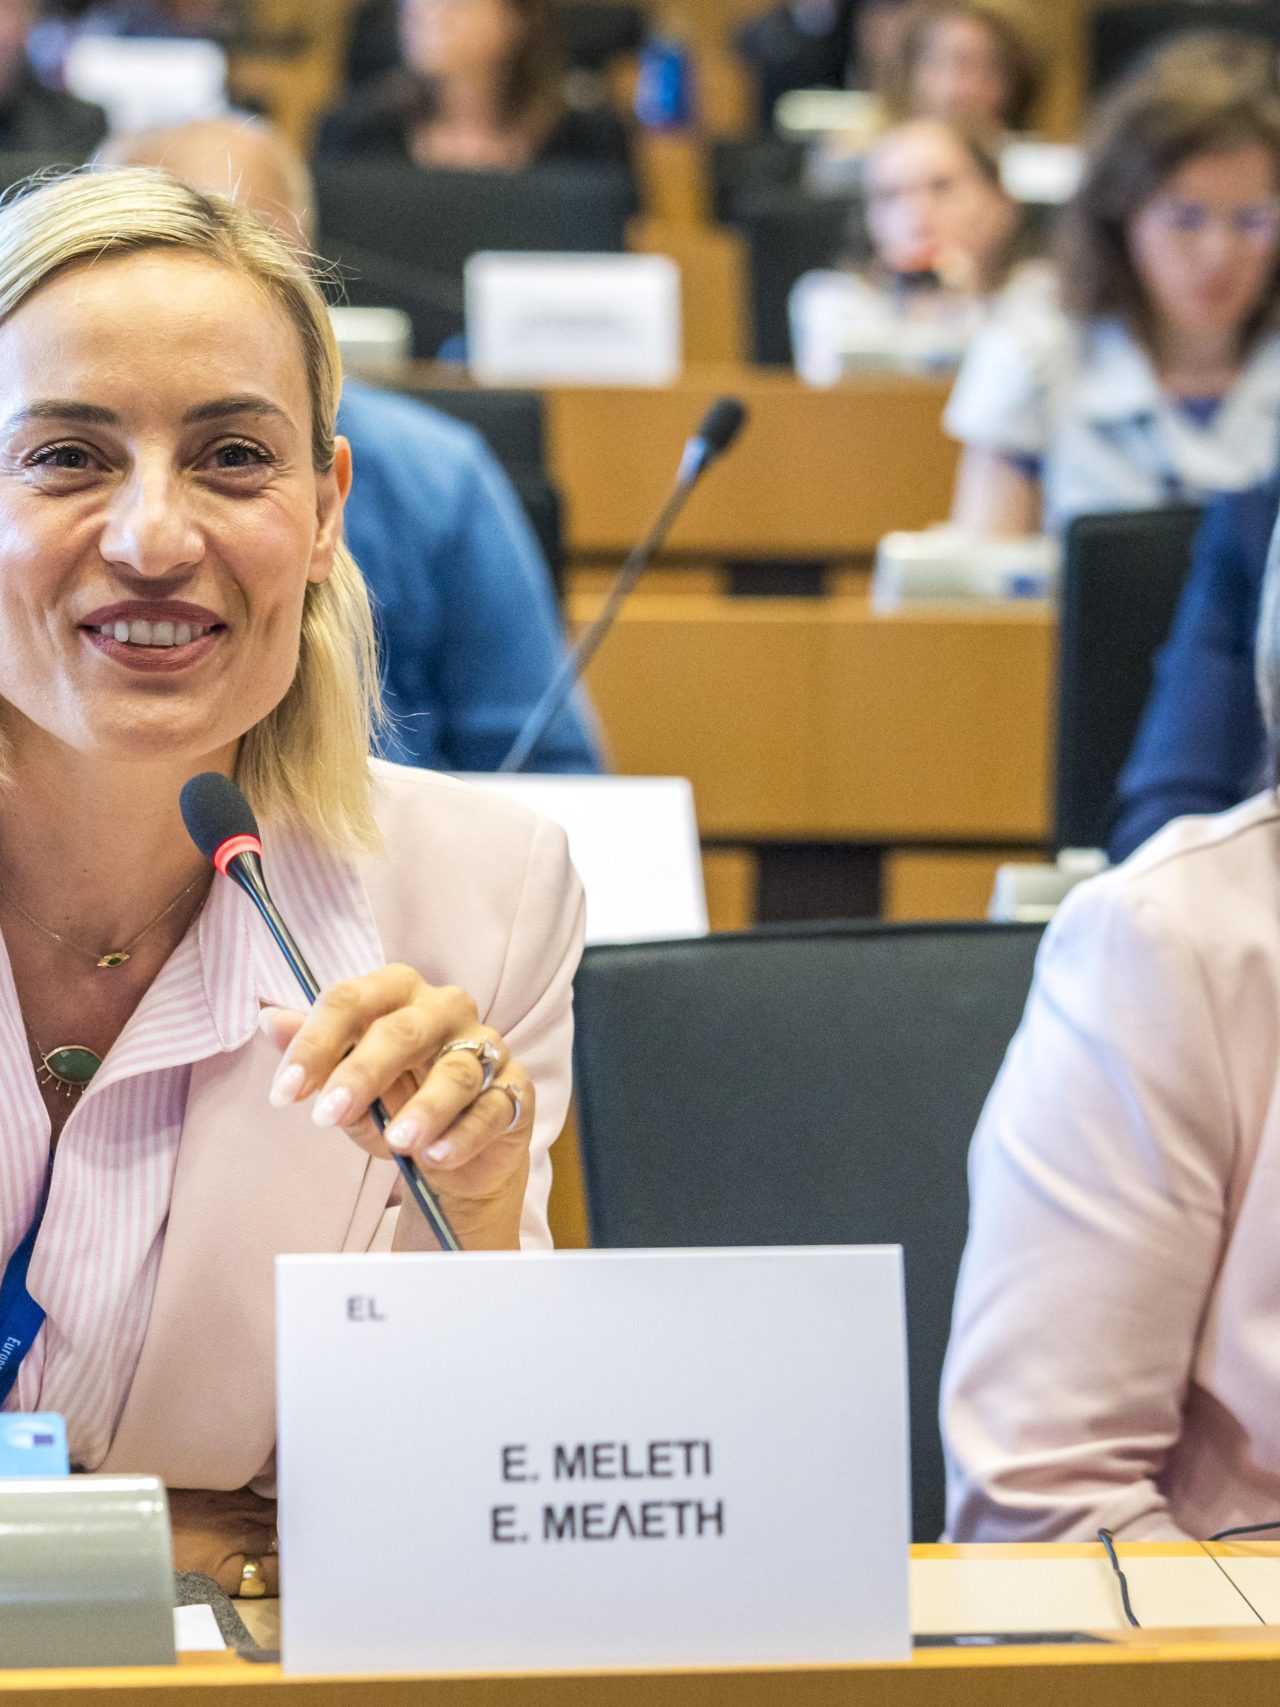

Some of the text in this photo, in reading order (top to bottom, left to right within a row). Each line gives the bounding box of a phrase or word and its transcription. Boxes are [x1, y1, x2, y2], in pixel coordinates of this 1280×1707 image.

[347, 1295, 386, 1321] EL
[502, 1440, 712, 1482] E. MELETI
[491, 1500, 725, 1543] Ε. ΜΕΛΕΤΗ
